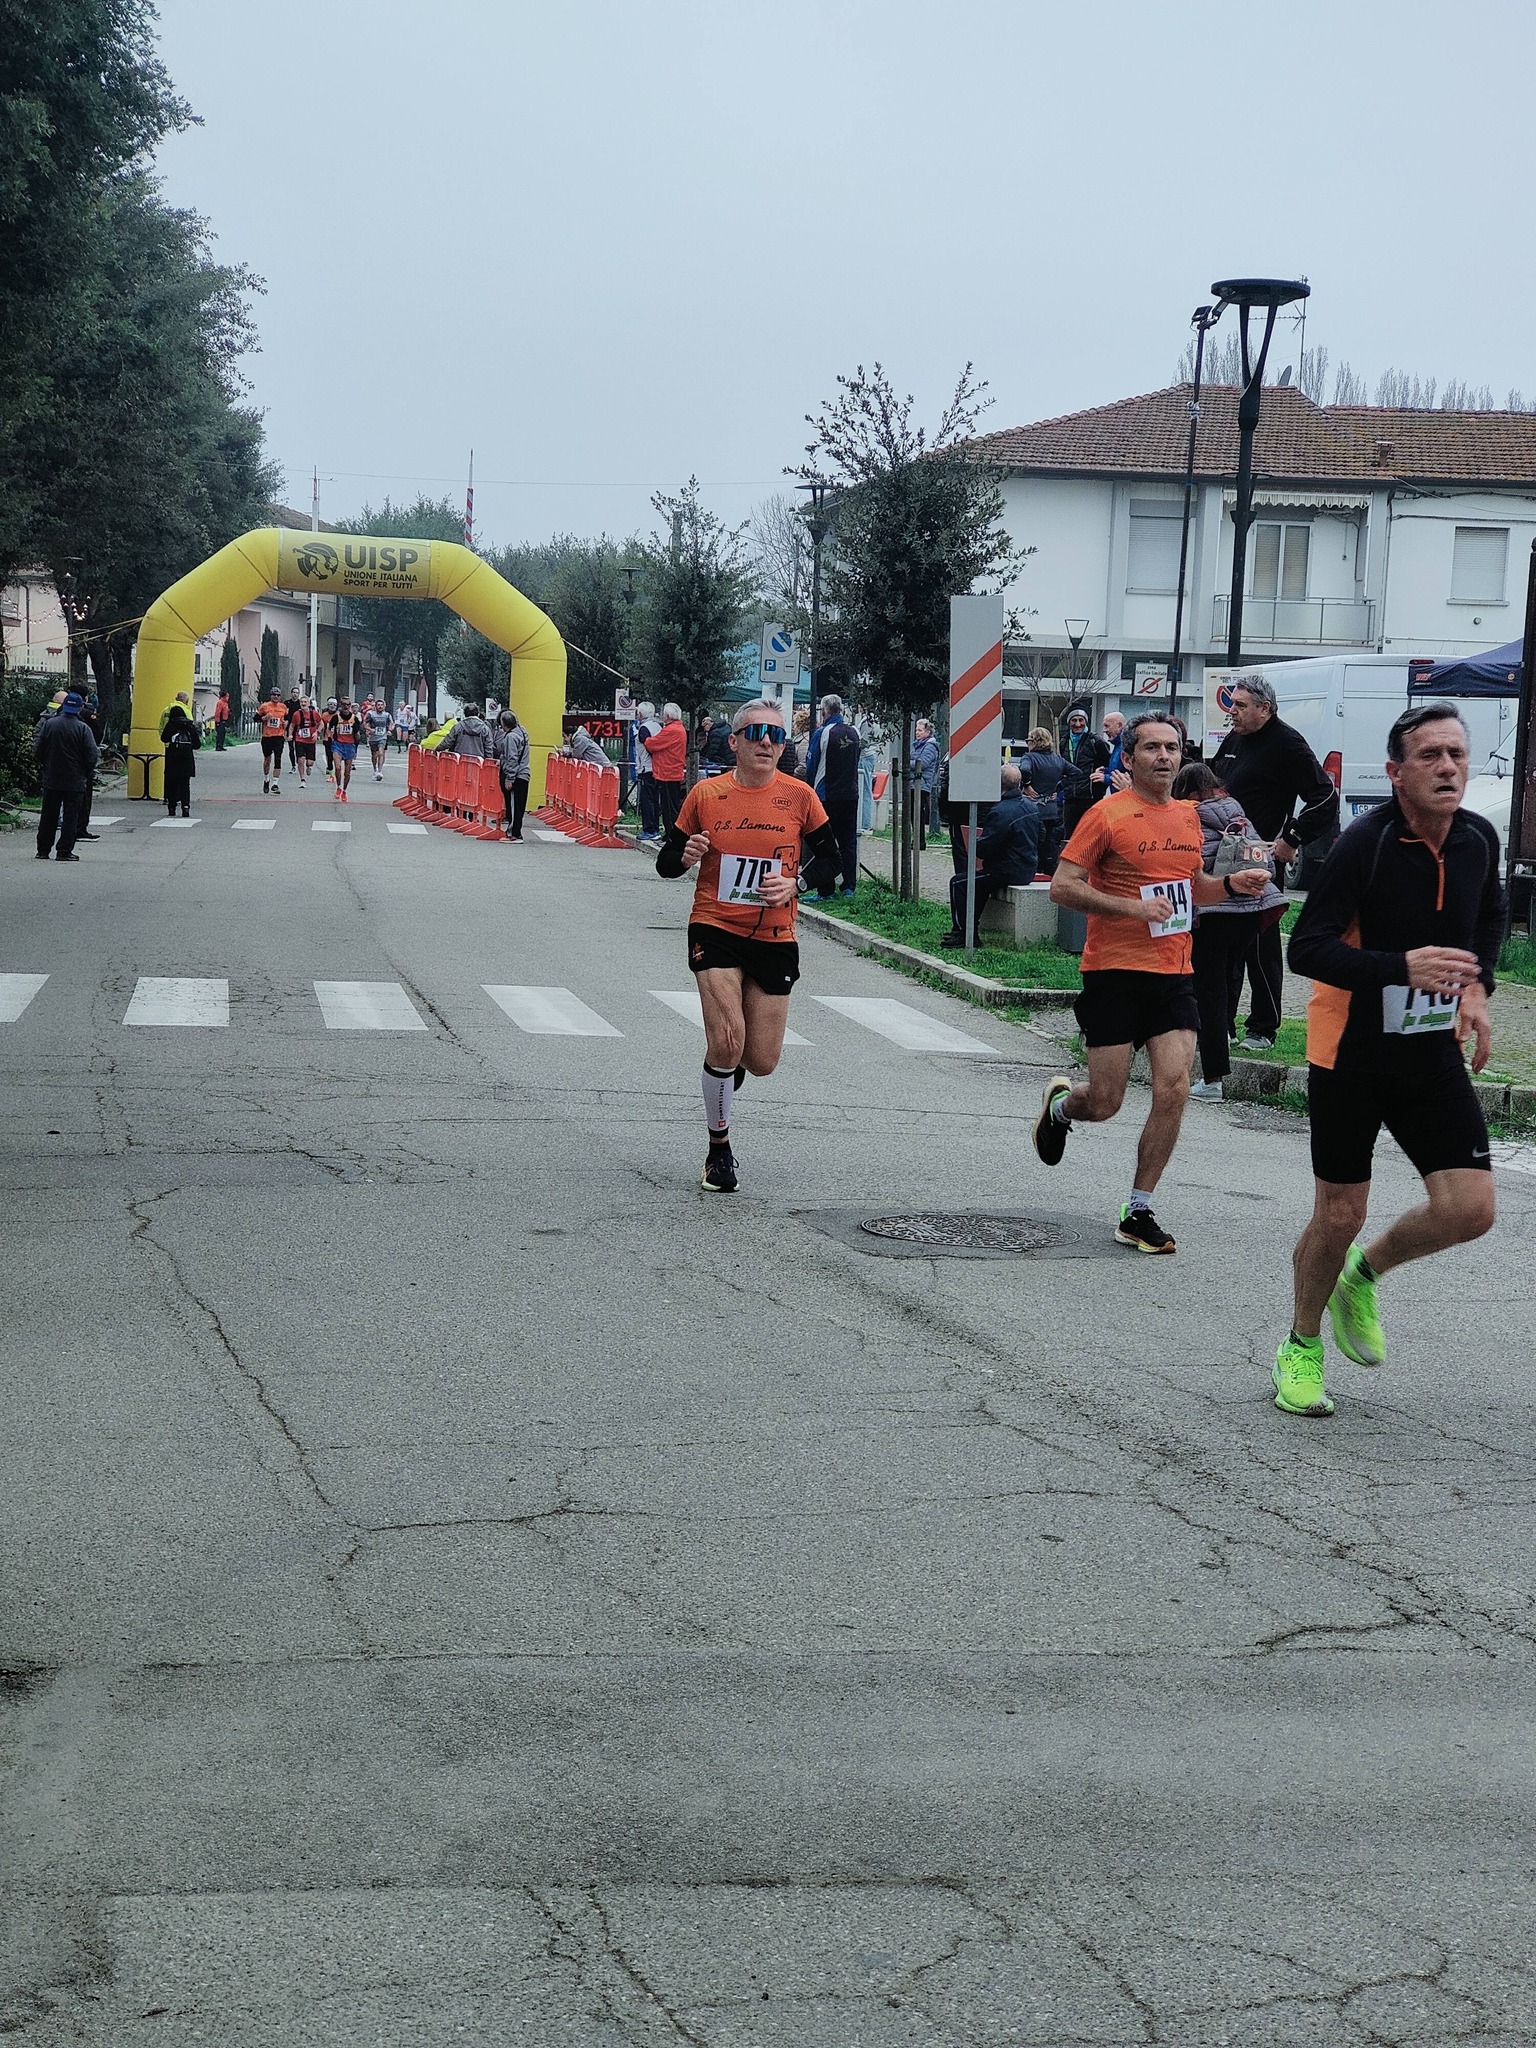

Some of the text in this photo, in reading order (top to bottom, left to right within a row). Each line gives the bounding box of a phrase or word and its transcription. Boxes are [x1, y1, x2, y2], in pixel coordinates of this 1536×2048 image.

[344, 544, 419, 572] UISP
[343, 579, 370, 587] SPORT
[391, 582, 413, 590] TUTTI
[344, 570, 418, 583] UNIONE ITALIANA
[766, 660, 775, 670] P
[714, 817, 786, 833] G.S. Lamone
[1138, 840, 1160, 856] G.S.
[1153, 882, 1188, 915] 44
